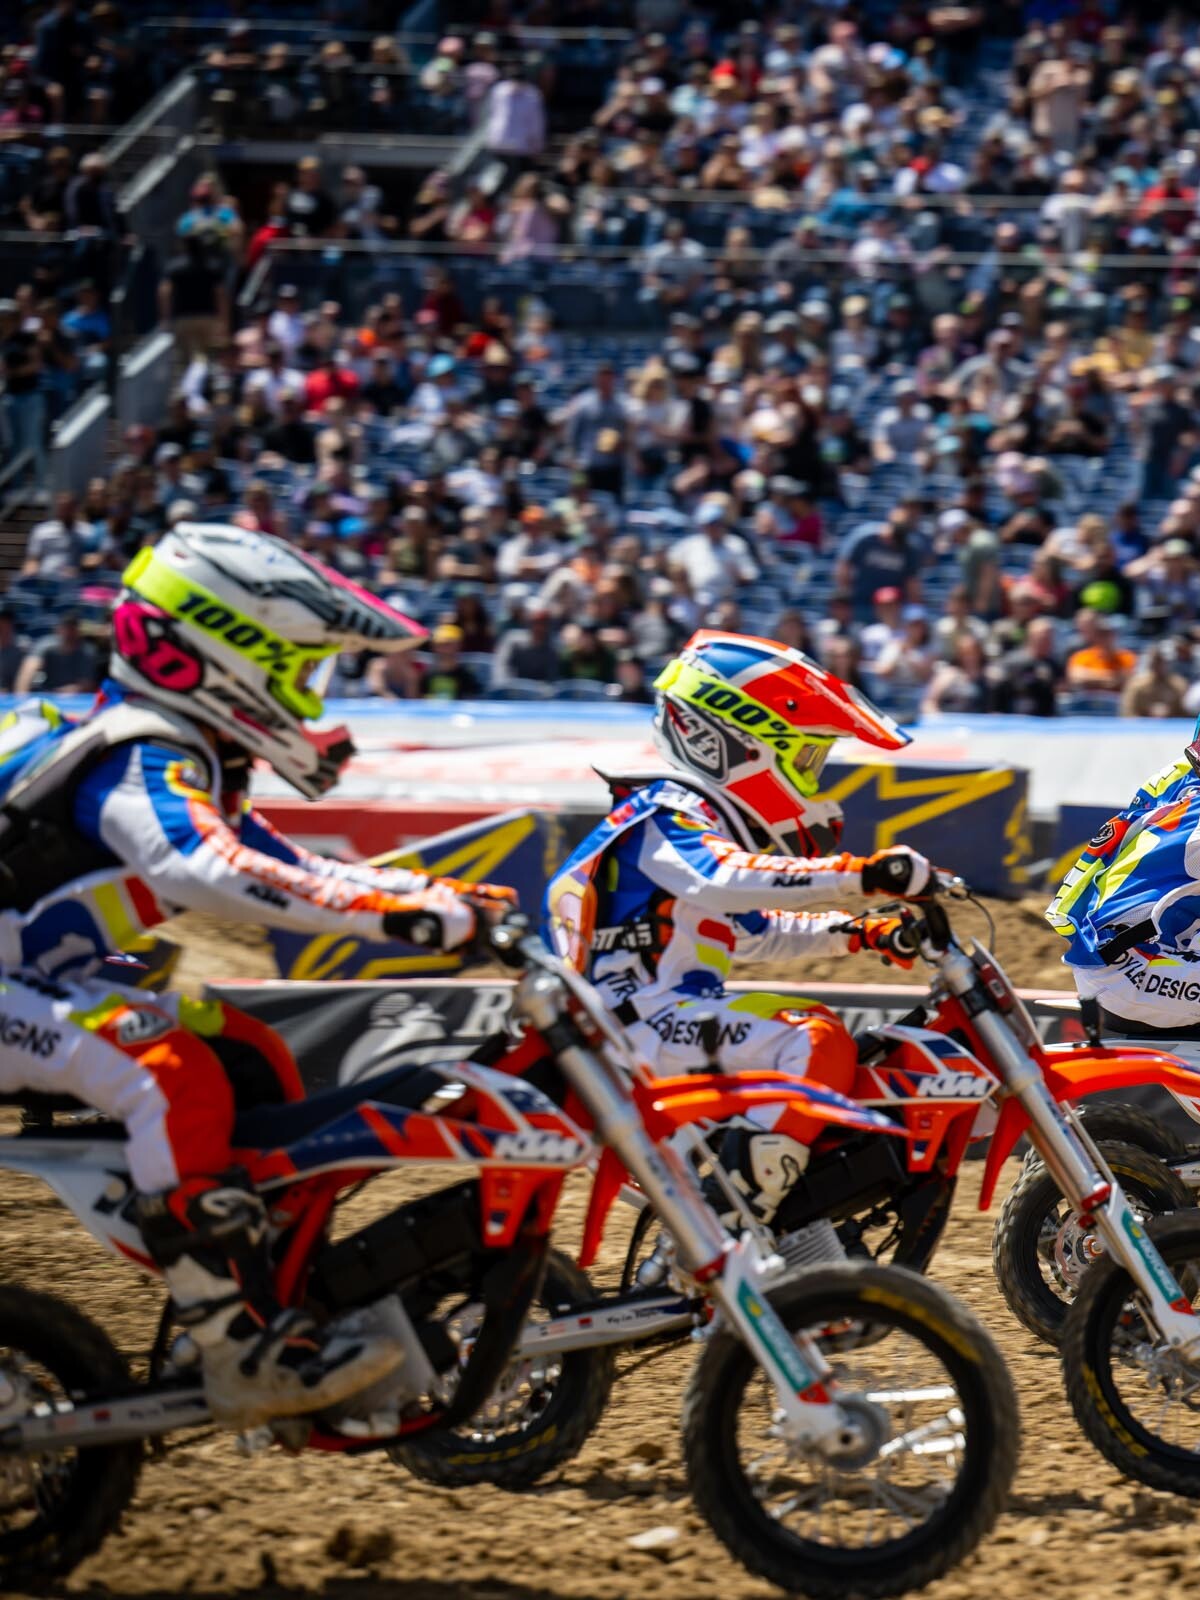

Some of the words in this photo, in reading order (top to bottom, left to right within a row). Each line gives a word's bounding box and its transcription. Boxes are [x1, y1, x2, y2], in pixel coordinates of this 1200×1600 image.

[177, 593, 297, 673] 100%
[691, 682, 801, 750] 100%
[917, 1071, 989, 1098] KTM
